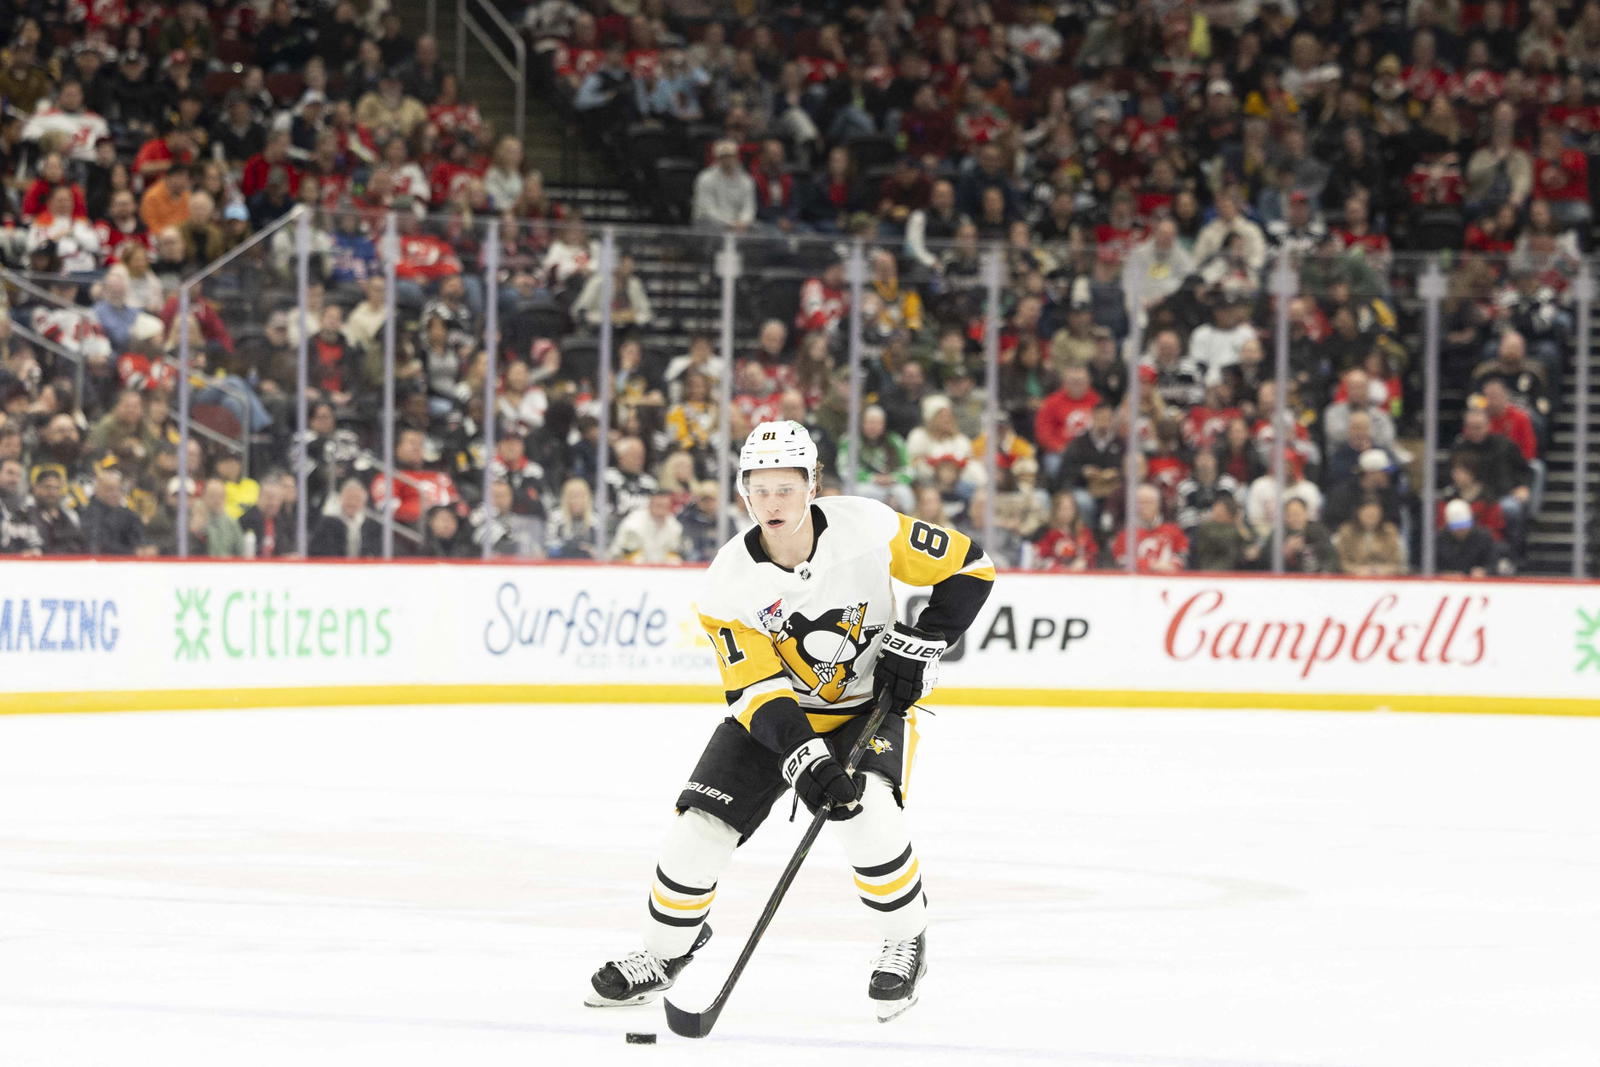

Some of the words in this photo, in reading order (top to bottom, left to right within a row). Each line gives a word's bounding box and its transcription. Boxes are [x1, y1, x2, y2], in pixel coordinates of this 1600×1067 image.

[762, 432, 776, 441] 81
[910, 520, 949, 558] 8
[222, 590, 393, 657] Citizens
[484, 581, 667, 656] Surfside
[1161, 588, 1489, 679] Campbell's
[706, 626, 746, 668] 1
[882, 632, 945, 659] BAUER
